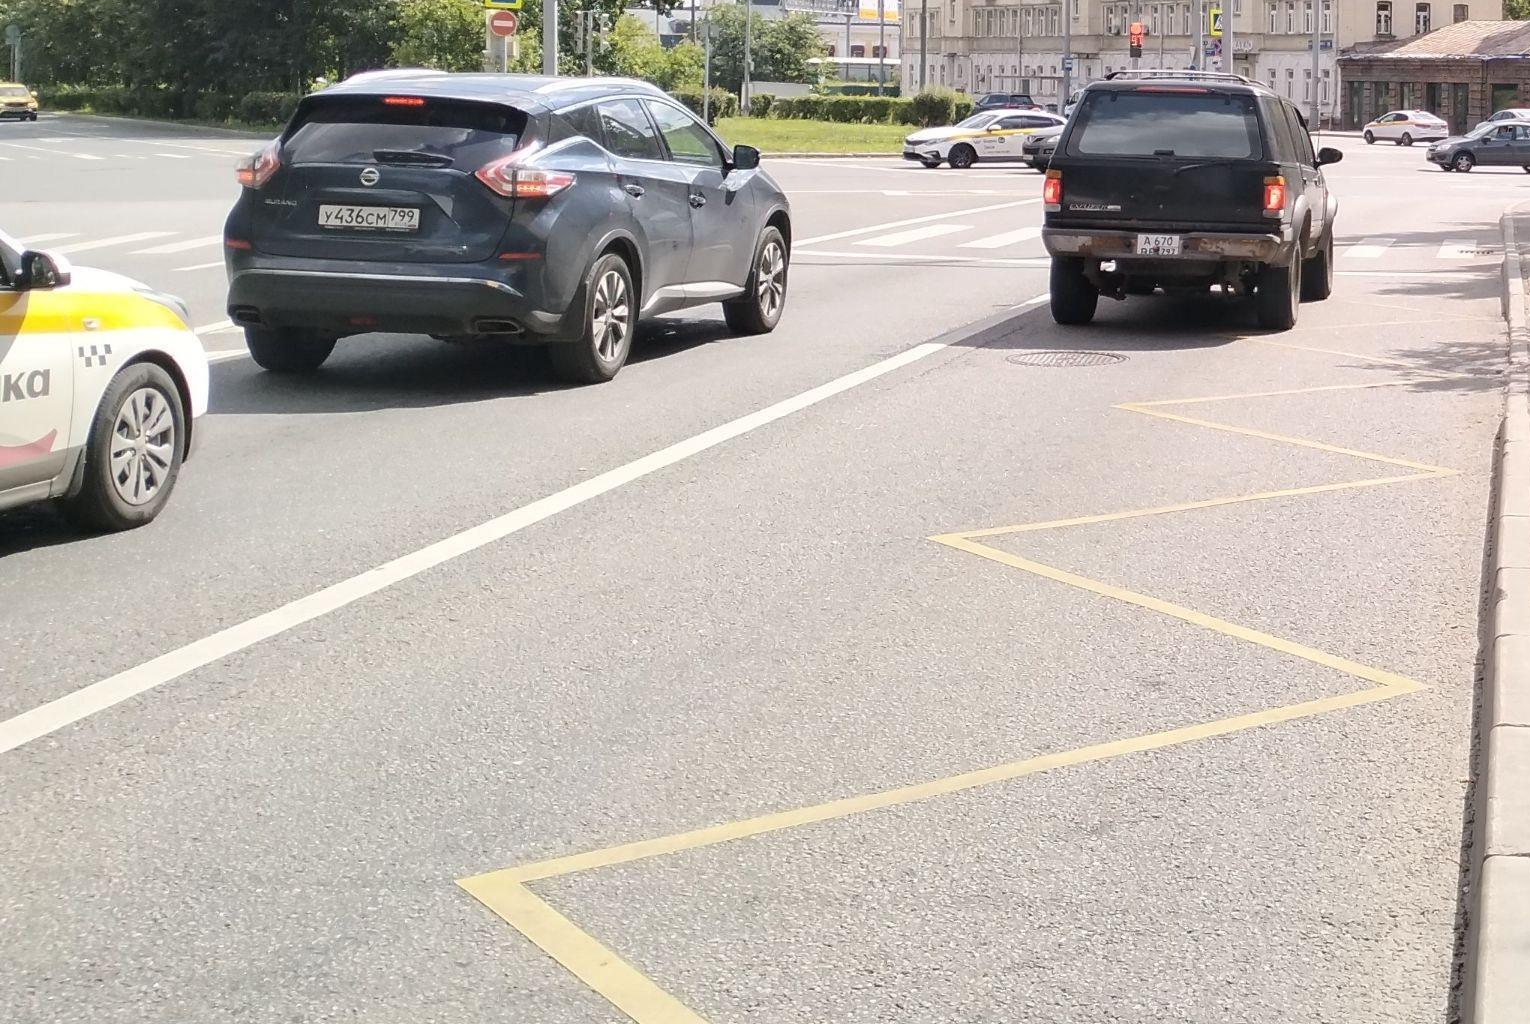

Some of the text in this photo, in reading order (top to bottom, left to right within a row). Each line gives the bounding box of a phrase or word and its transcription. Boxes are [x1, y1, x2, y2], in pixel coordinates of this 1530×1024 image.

[324, 208, 416, 226] У436СМ 799
[1154, 236, 1173, 246] 670
